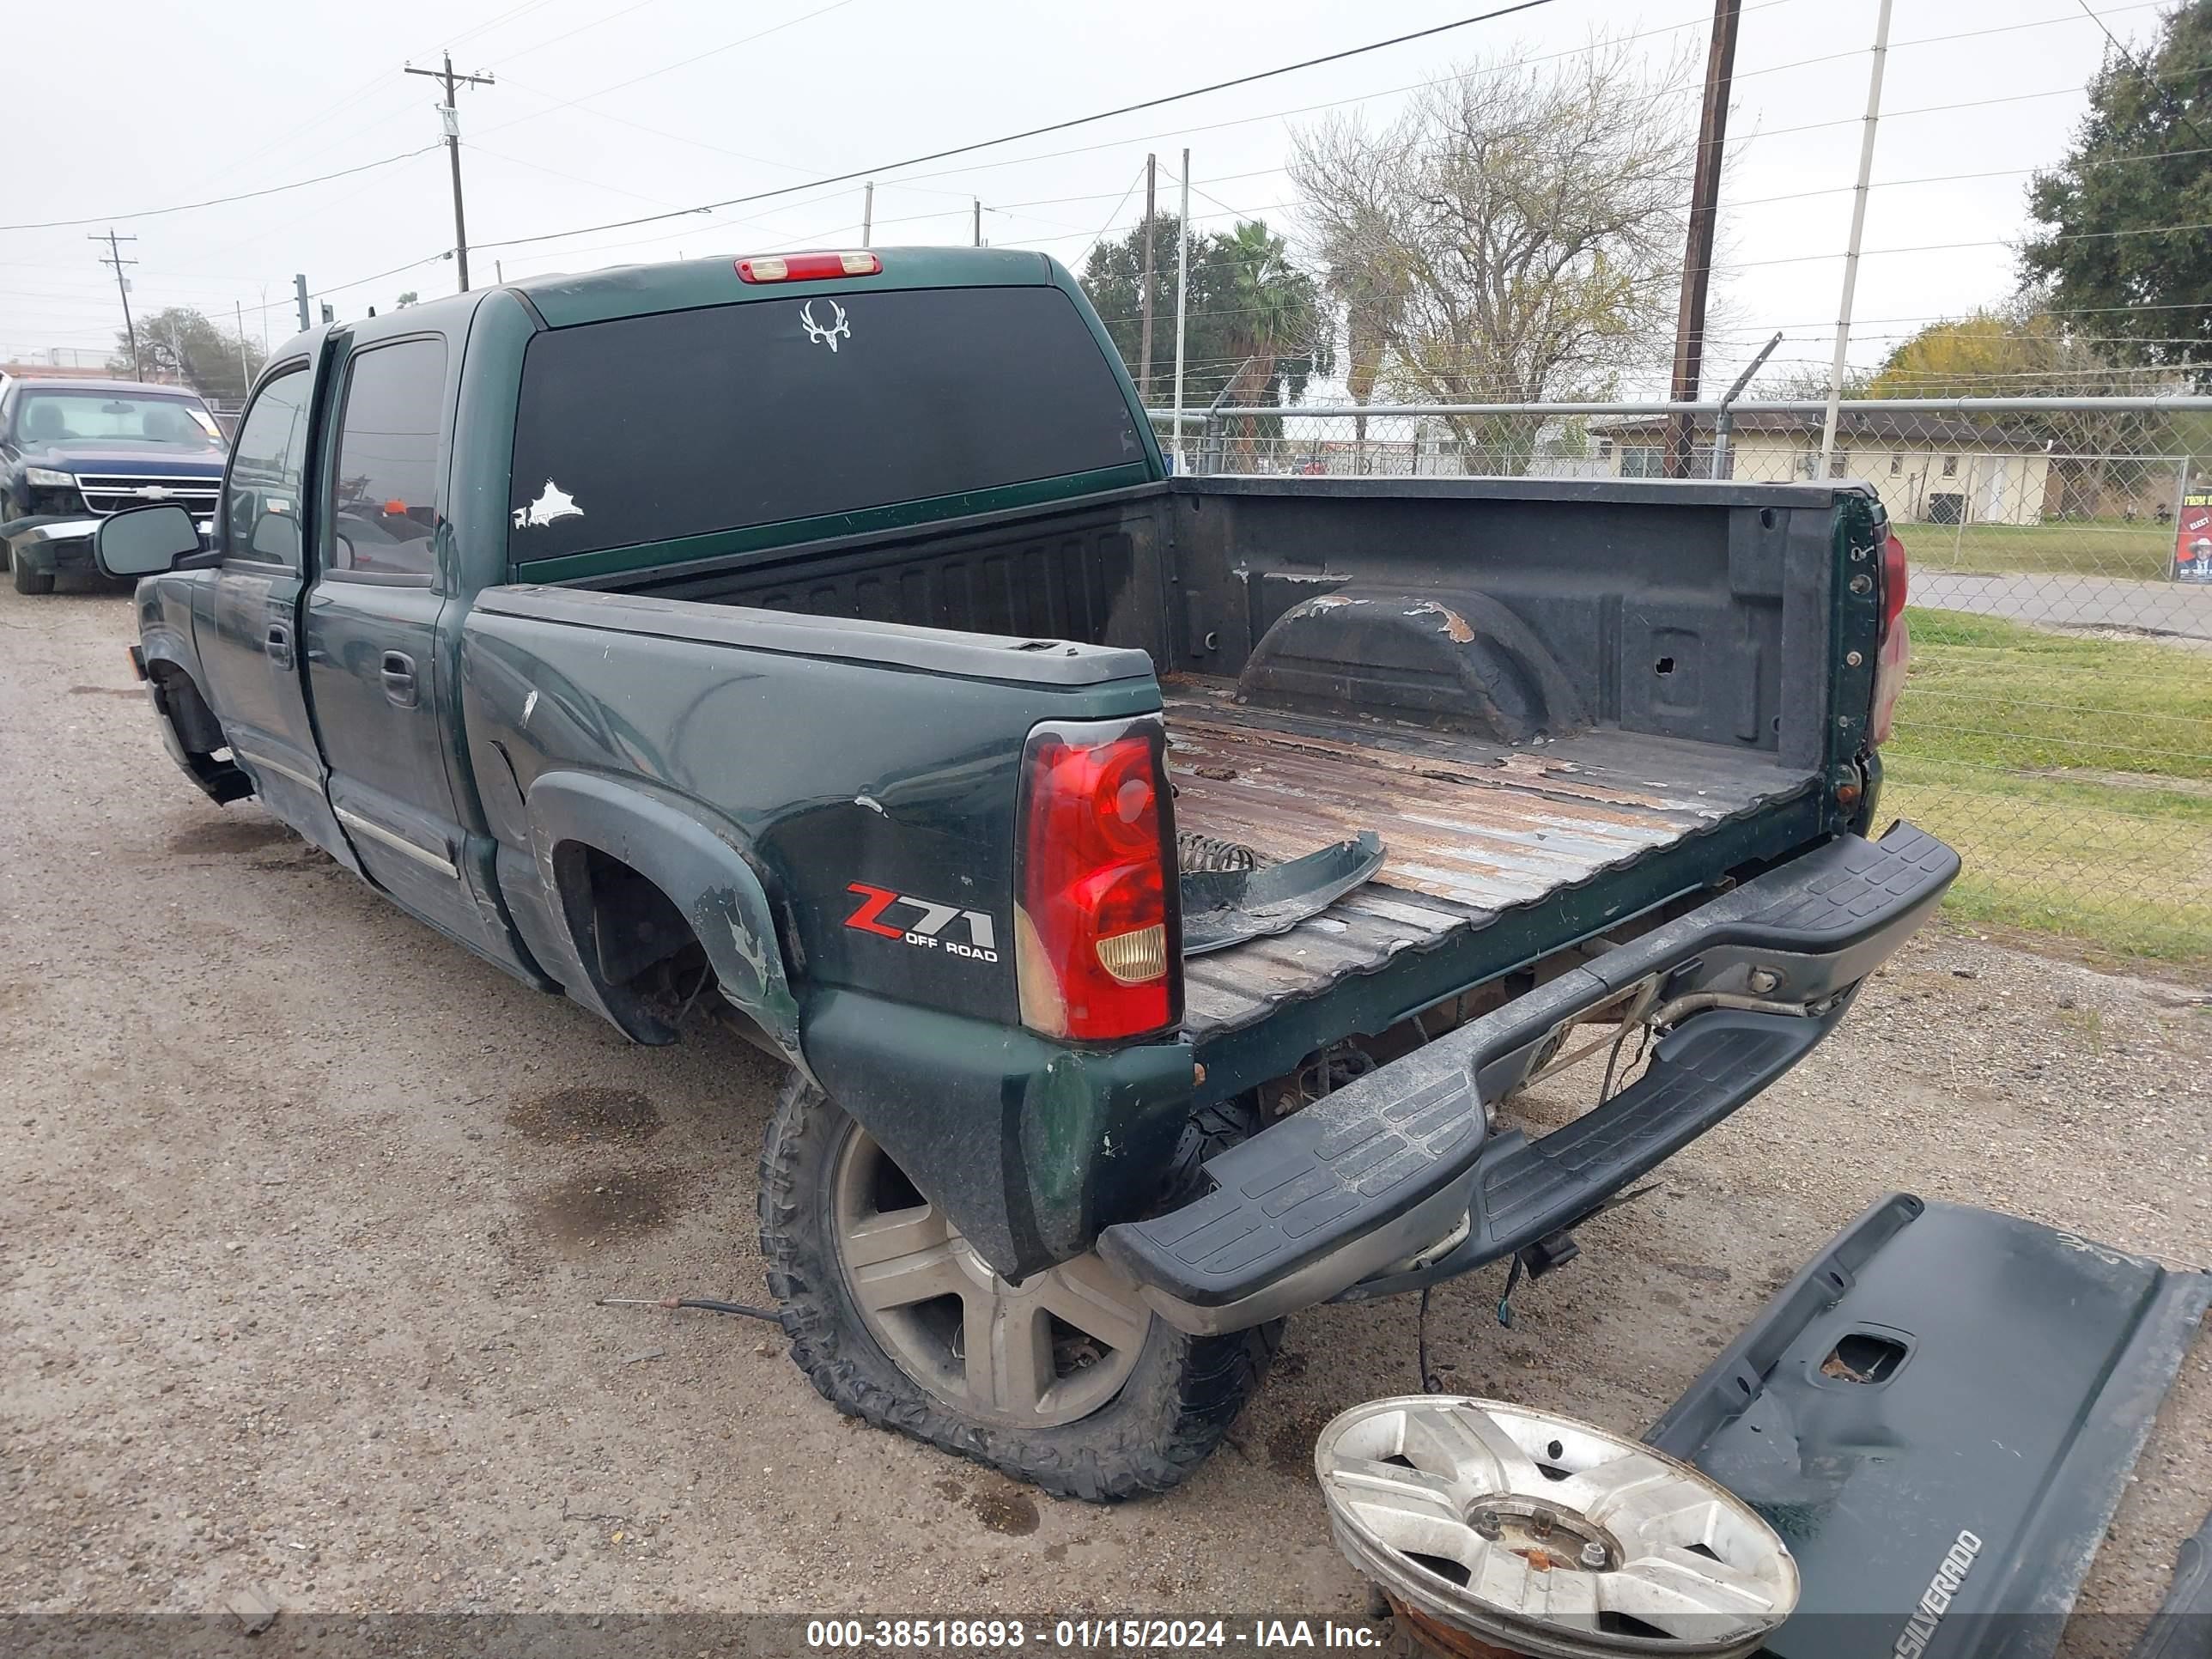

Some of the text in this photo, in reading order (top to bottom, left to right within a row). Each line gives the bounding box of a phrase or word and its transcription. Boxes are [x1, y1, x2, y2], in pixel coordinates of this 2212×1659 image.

[2190, 517, 2209, 530] ELECT
[844, 883, 995, 949] Z71
[905, 932, 998, 963] OFF ROAD
[1896, 1529, 1983, 1659] SILVERADO
